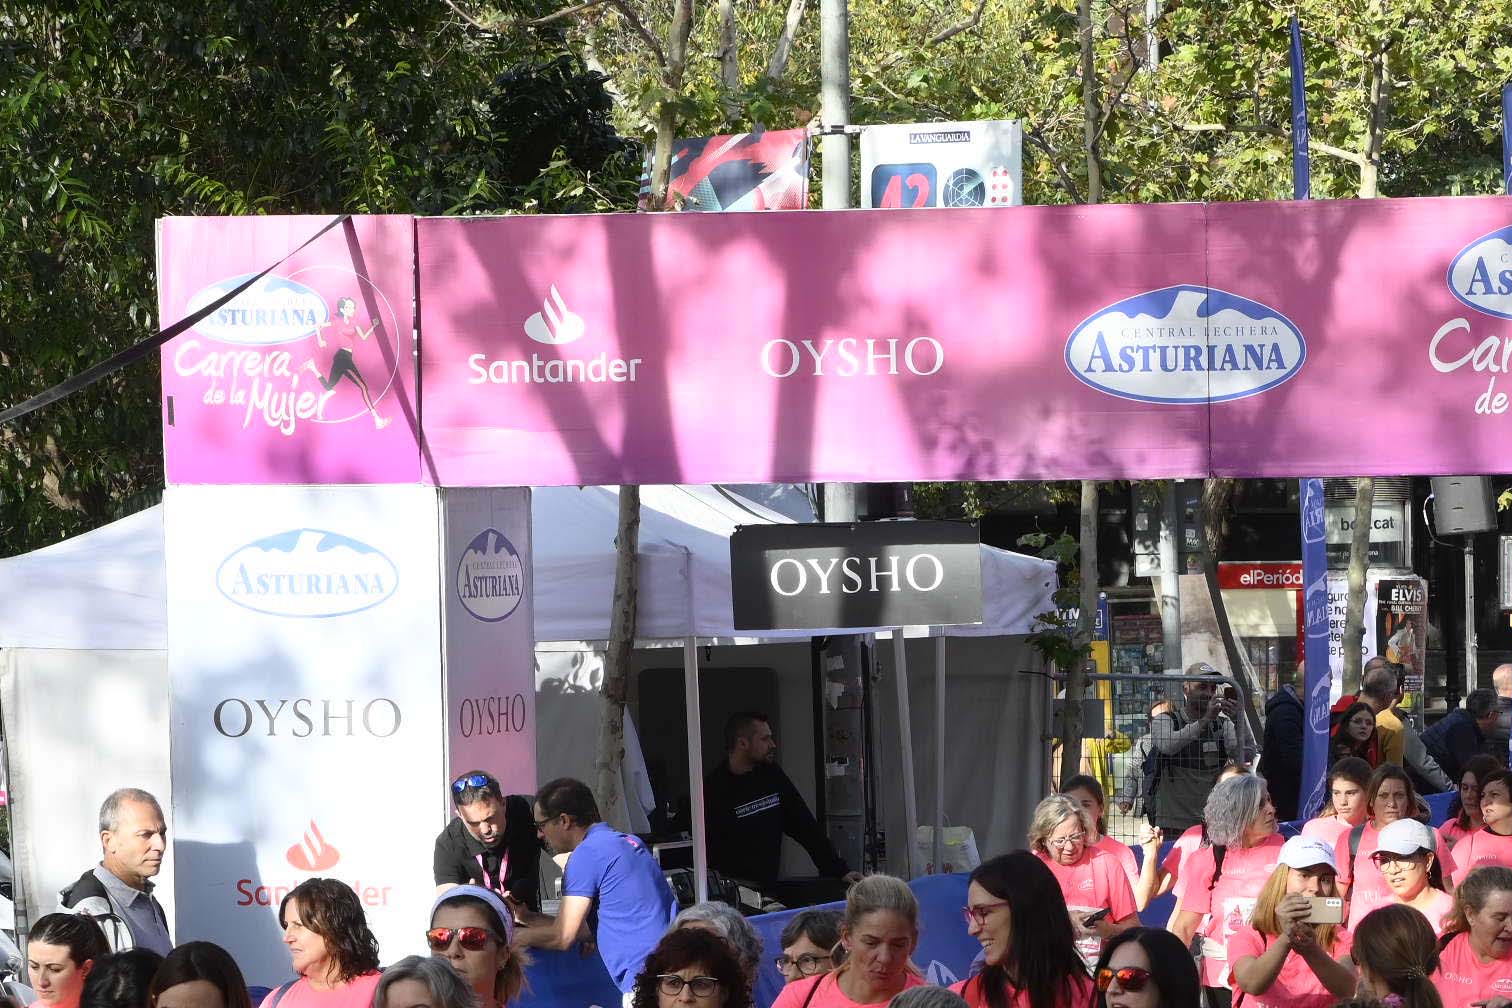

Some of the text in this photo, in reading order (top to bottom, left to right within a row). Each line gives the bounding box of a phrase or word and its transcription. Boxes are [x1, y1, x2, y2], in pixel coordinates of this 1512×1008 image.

[1121, 325, 1280, 338] CENTRAL LECHERA
[174, 339, 292, 377] Carrera
[468, 352, 642, 384] Santander
[760, 337, 944, 379] OYSHO
[1084, 330, 1286, 374] ASTURIANA
[203, 369, 336, 436] de la Mujer
[1475, 376, 1508, 415] de
[231, 563, 386, 595] ASTURIANA
[462, 564, 520, 598] ASTURIANA
[771, 554, 944, 597] OYSHO
[1391, 589, 1422, 601] ELVIS
[214, 698, 402, 738] OYSHO
[459, 693, 526, 738] OYSHO
